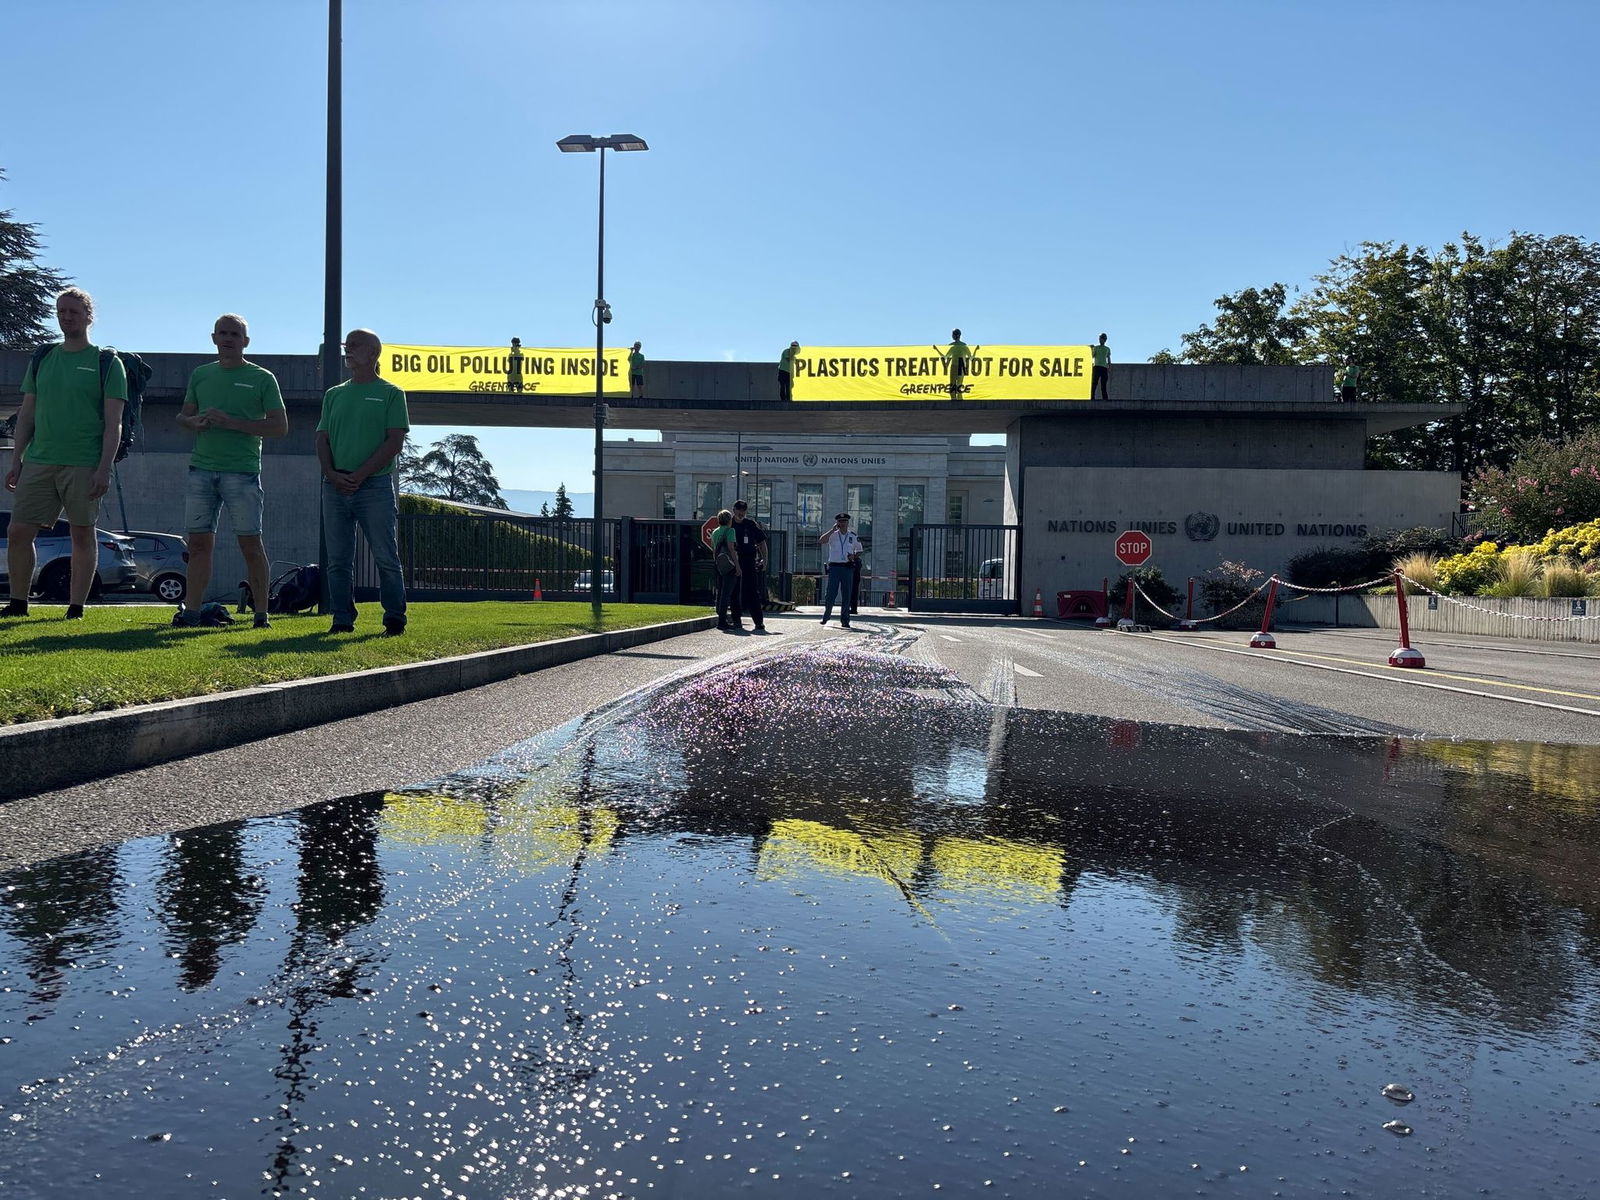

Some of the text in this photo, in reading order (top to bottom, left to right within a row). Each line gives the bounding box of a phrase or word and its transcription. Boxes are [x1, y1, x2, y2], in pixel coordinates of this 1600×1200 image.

[392, 354, 619, 377] BIG OIL POLLUTING INSIDE
[795, 357, 1083, 378] PLASTICS TREATY NOT FOR SALE
[469, 380, 541, 393] GREENPEACE
[900, 383, 974, 395] GREENPEACE
[765, 456, 799, 464] NATIONS
[861, 457, 886, 465] UNIES
[1047, 520, 1367, 537] NATIONS UNIES UNITED NATIONS
[1119, 542, 1148, 554] STOP
